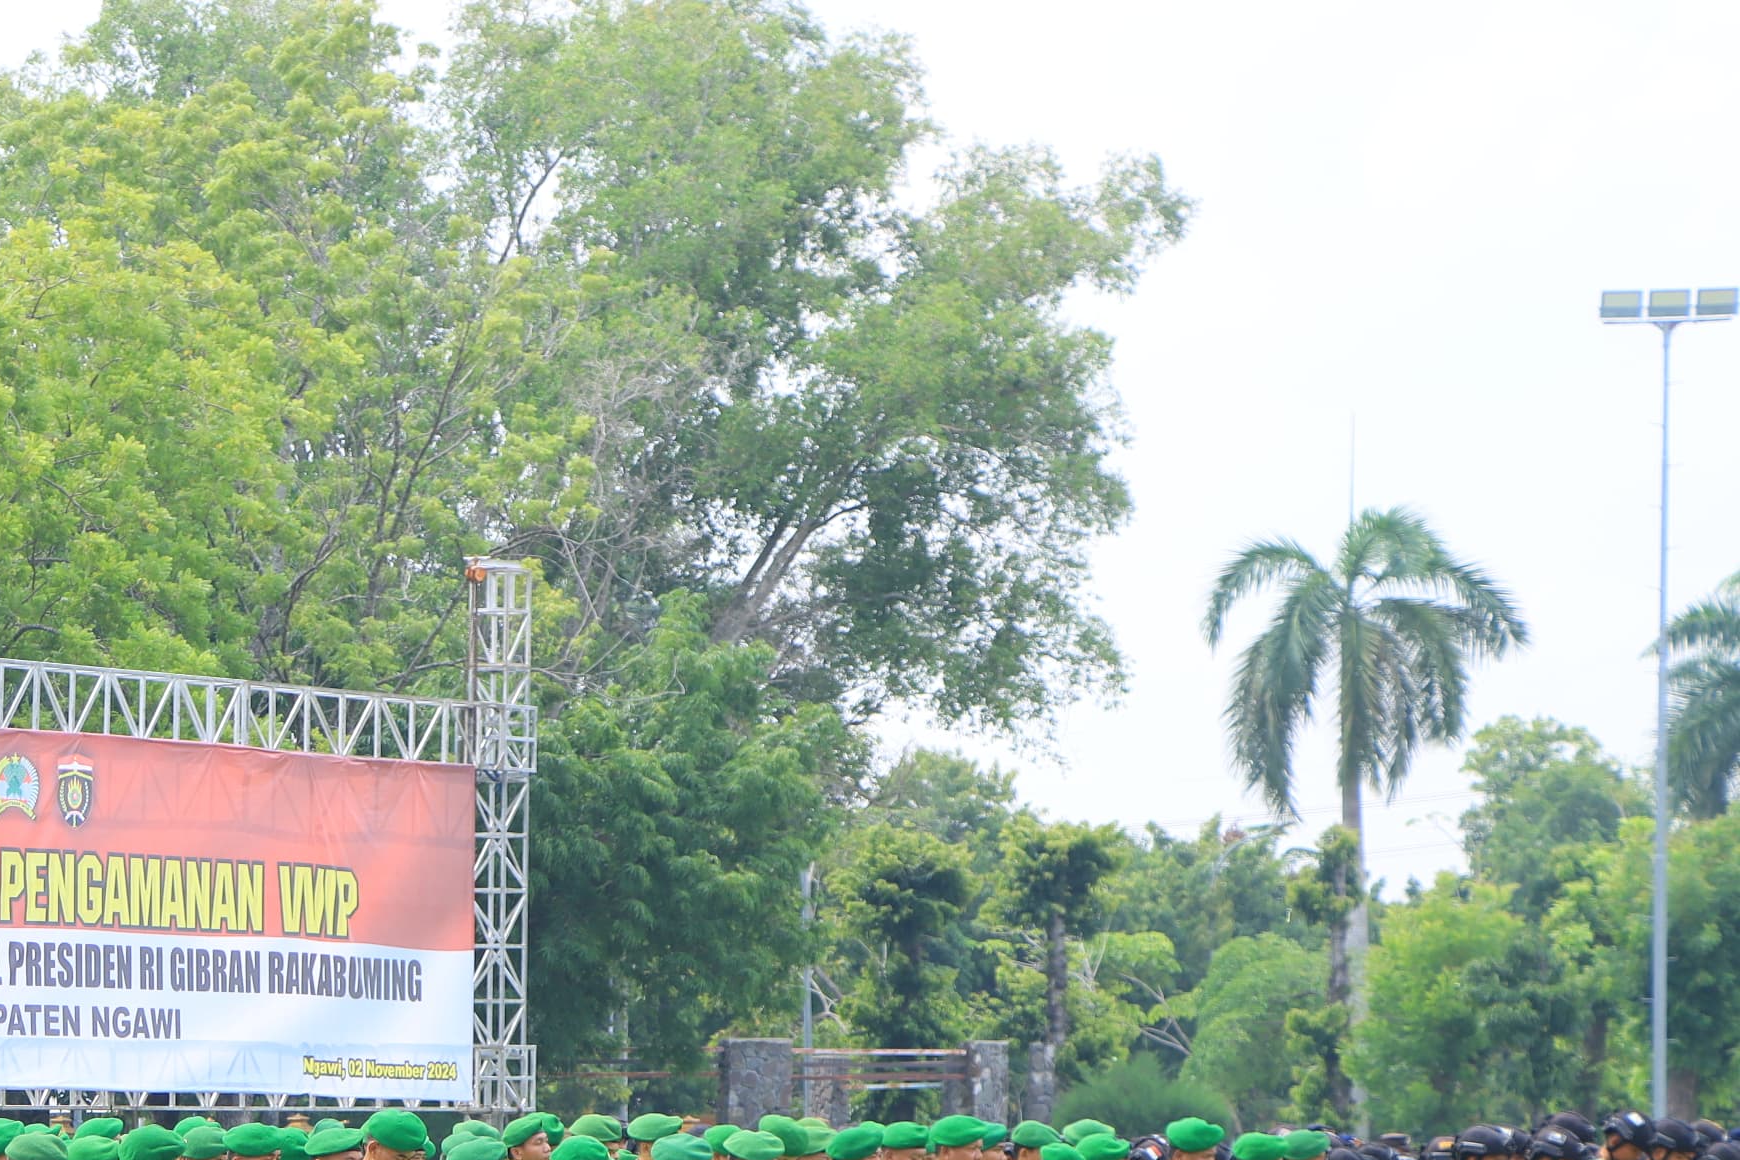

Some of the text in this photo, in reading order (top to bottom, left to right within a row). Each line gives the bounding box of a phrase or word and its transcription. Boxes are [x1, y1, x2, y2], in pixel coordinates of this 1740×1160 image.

[9, 941, 132, 990] PRESIDEN
[139, 946, 163, 991] RI
[169, 948, 260, 994] GIBRAN
[268, 951, 422, 1001] RAKABUMING
[91, 1006, 182, 1040] NGAWI
[303, 1056, 457, 1080] Ngawi, 02 November 2024
